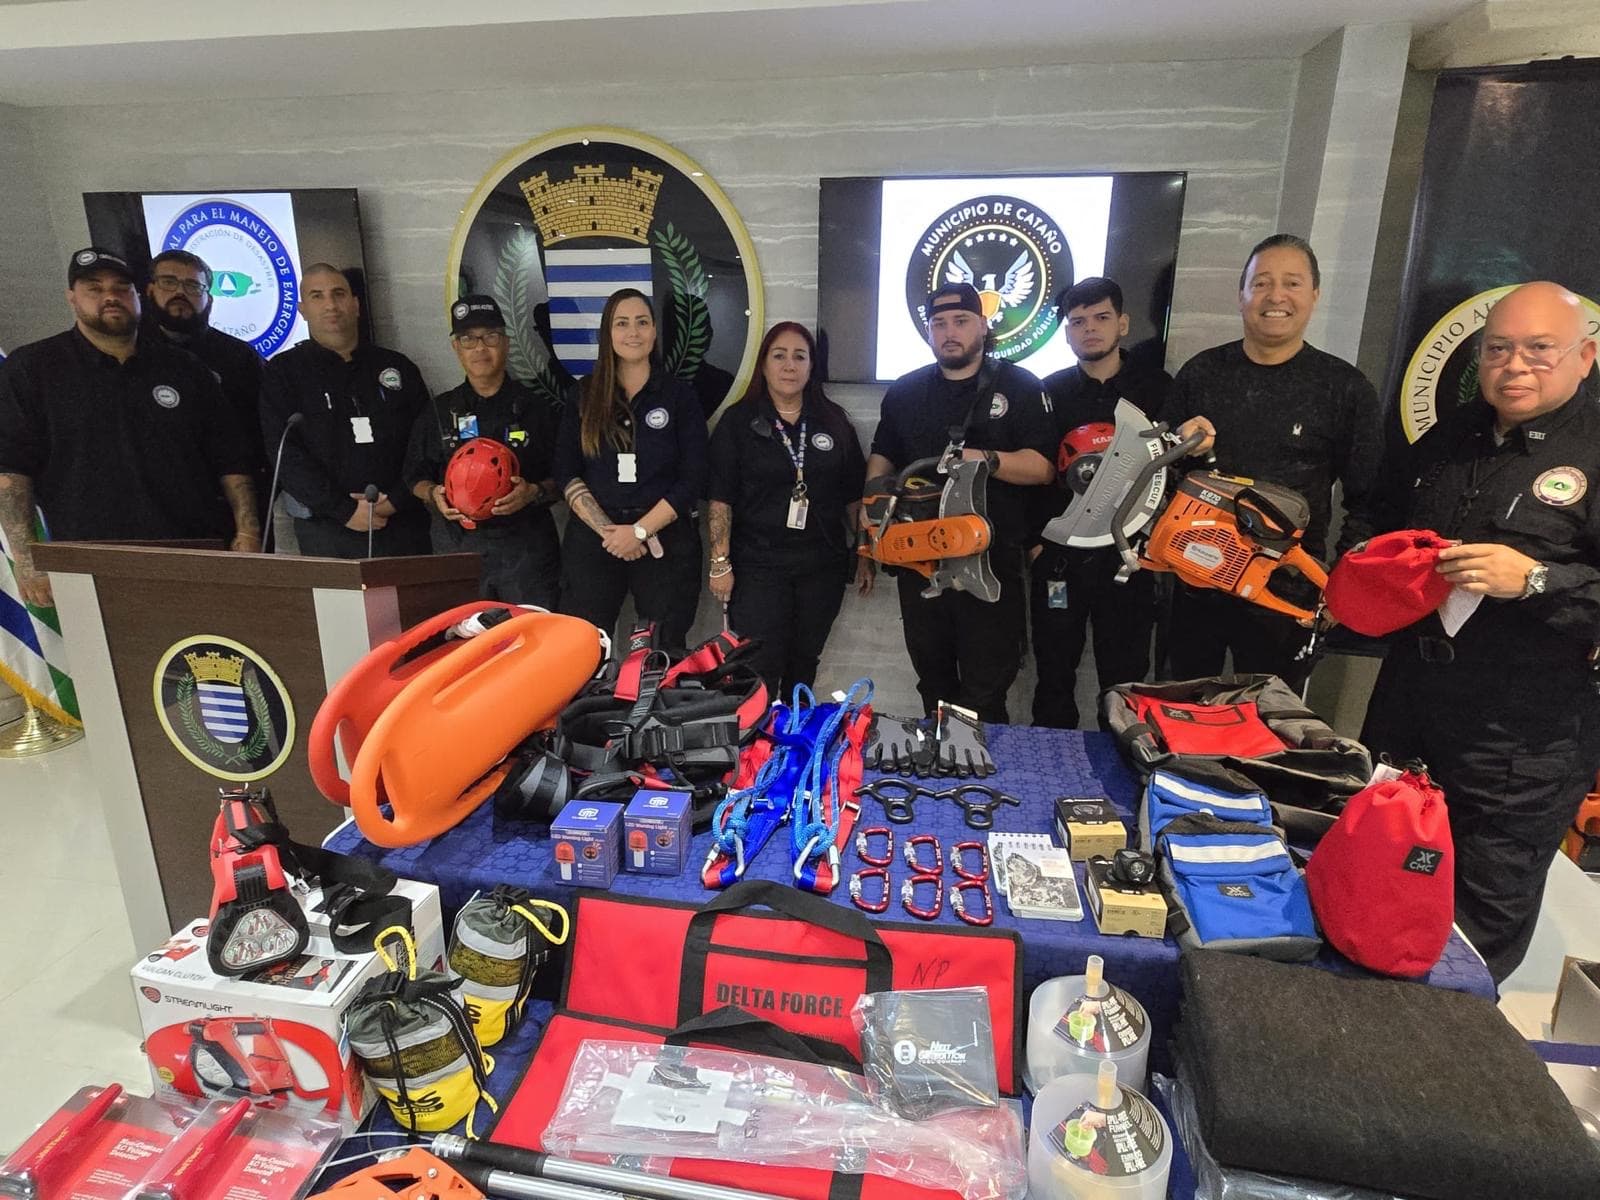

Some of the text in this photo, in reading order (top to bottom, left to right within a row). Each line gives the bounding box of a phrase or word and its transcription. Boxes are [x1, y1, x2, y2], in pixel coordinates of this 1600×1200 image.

[178, 211, 209, 234] PARA
[211, 207, 226, 219] EL
[229, 210, 279, 252] MANEJO
[275, 255, 291, 276] DE
[921, 202, 1062, 257] MUNICIPIO DE CATAÑO
[1033, 305, 1060, 340] PÚBLICA
[1413, 321, 1465, 432] MUNICIPIO
[1147, 469, 1162, 508] ESCUE
[1408, 860, 1434, 873] CMC
[164, 995, 234, 1014] STREAMLIGHT
[716, 982, 846, 1018] DELTA FORCE
